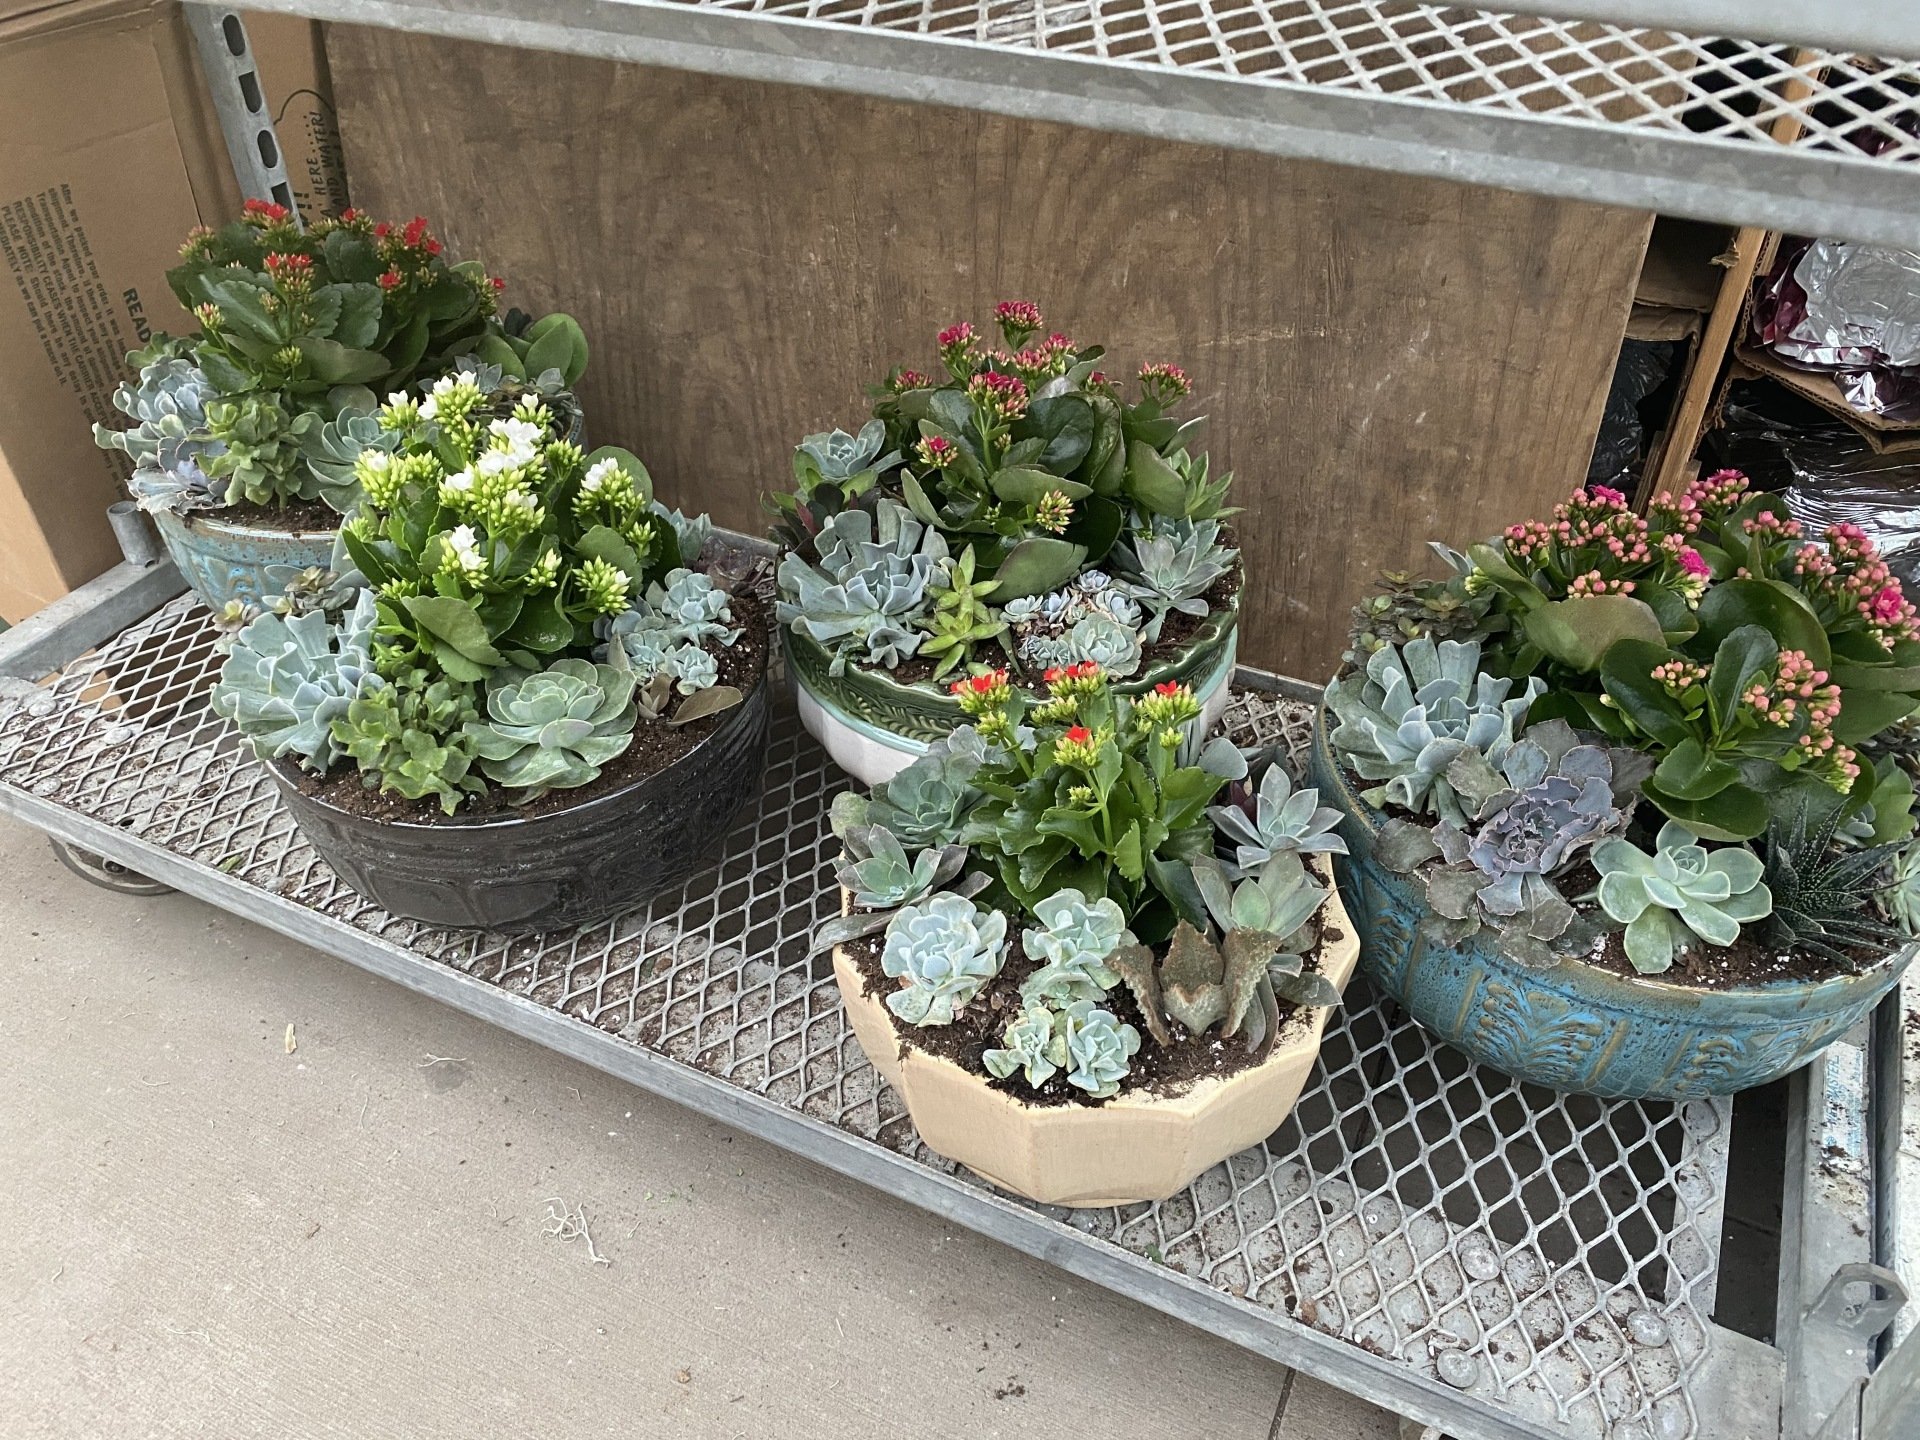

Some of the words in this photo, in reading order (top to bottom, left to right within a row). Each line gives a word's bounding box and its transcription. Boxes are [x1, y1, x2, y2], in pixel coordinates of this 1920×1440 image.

[309, 111, 332, 167] WATER!
[60, 184, 72, 204] After
[328, 177, 341, 205] AND
[70, 209, 79, 222] we
[74, 226, 93, 257] packed
[25, 197, 45, 238] condition
[41, 240, 51, 249] of
[47, 251, 56, 266] the
[64, 296, 73, 311] the
[83, 346, 92, 354] of
[37, 192, 65, 255] Transportation
[61, 258, 76, 282] Agent
[71, 283, 80, 293] to
[87, 327, 100, 345] your
[86, 260, 99, 279] your
[1, 206, 22, 241] PLEASE
[30, 277, 48, 308] Should
[44, 311, 58, 334] there
[61, 352, 72, 367] any
[13, 201, 48, 273] RESPONSIBILITY
[43, 276, 62, 310] CEASES
[57, 310, 72, 337] WHEN
[68, 337, 80, 354] THE
[75, 355, 95, 390] CARRIER
[21, 287, 31, 300] we
[96, 283, 109, 305] order
[27, 301, 38, 317] can
[86, 288, 98, 310] there
[99, 322, 108, 337] any
[123, 288, 151, 343] READ
[32, 318, 45, 333] put
[110, 319, 120, 335] was
[43, 340, 58, 364] tracer
